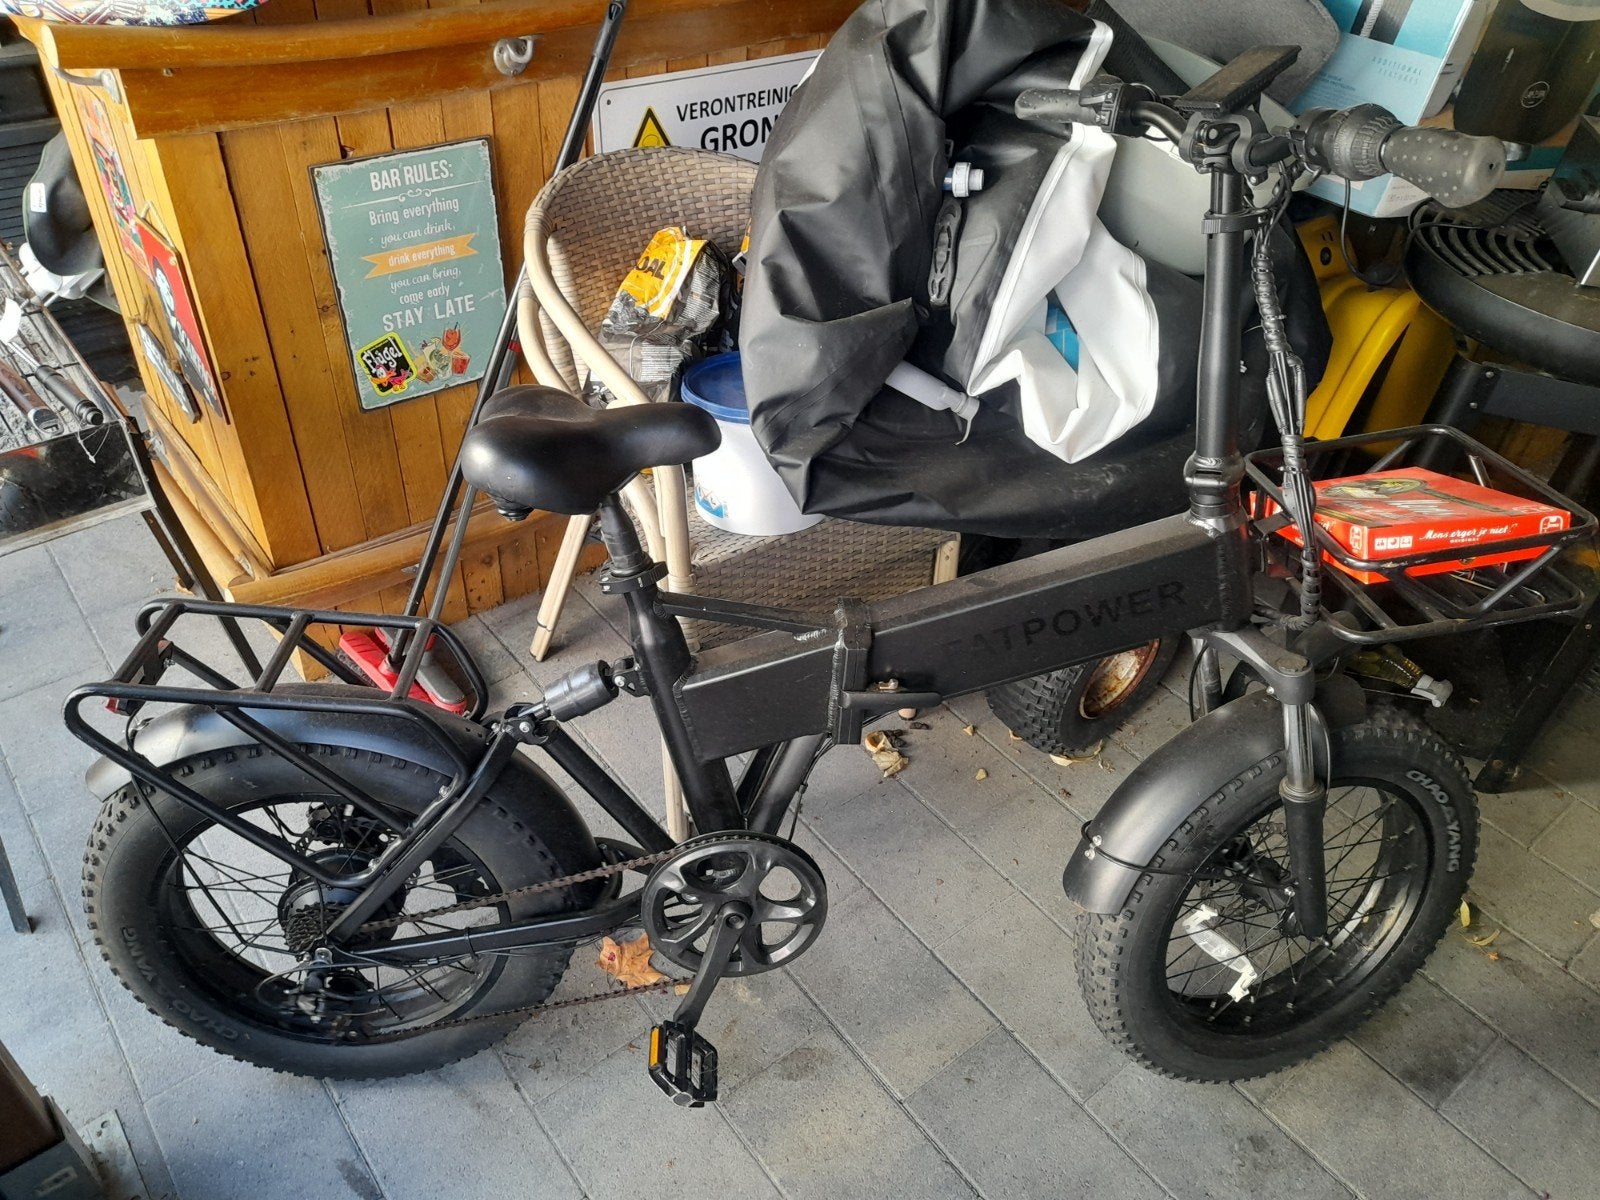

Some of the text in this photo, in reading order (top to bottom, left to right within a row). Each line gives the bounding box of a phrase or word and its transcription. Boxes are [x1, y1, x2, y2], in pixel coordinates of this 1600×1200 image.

[370, 160, 454, 191] BAR RULES:
[369, 199, 459, 226] Bring everything
[381, 233, 401, 248] you
[401, 230, 422, 241] can
[388, 244, 455, 267] drink everything
[390, 278, 410, 294] you
[411, 274, 431, 285] can
[400, 283, 450, 305] come early
[382, 294, 475, 332] STAY LATE
[1419, 529, 1449, 540] Mens
[1450, 528, 1477, 539] erger
[1477, 527, 1488, 537] je
[1406, 770, 1461, 873] CHAO YANG
